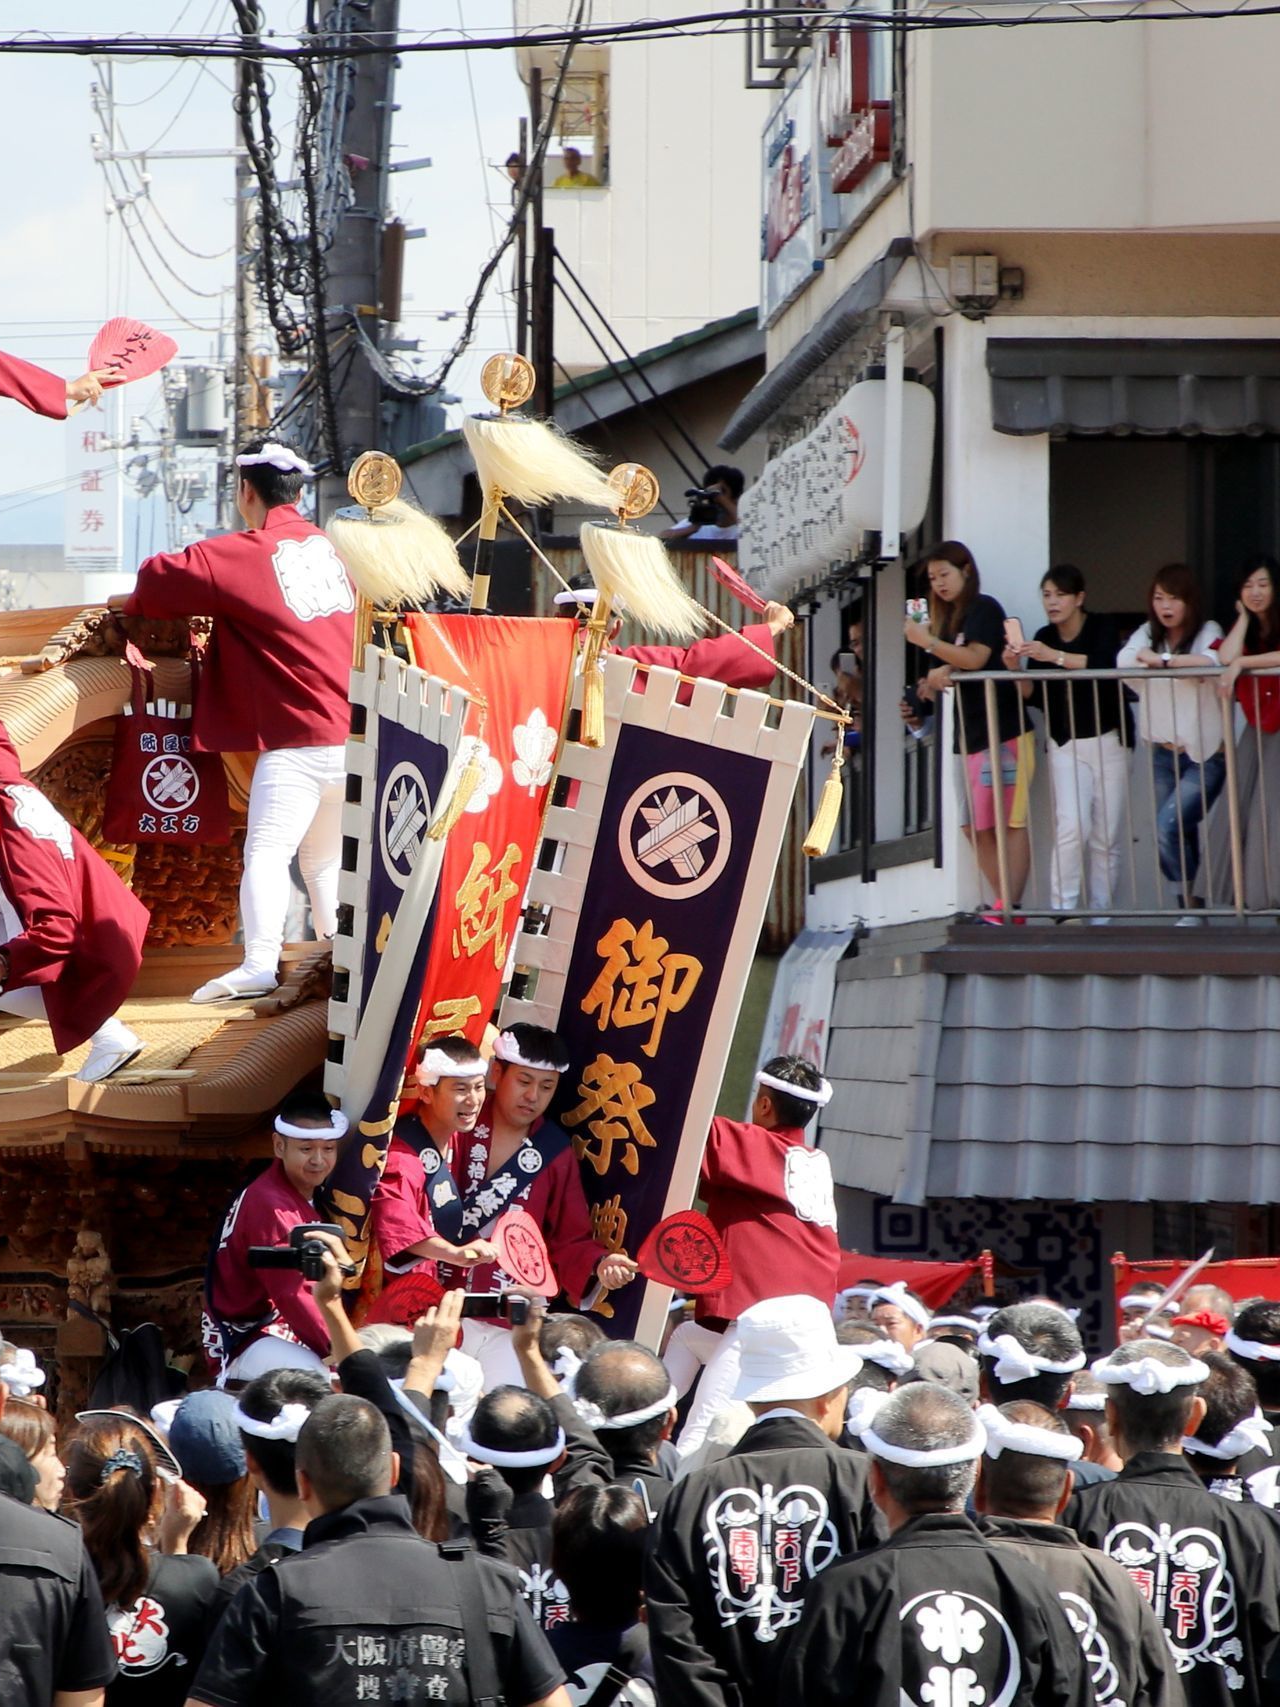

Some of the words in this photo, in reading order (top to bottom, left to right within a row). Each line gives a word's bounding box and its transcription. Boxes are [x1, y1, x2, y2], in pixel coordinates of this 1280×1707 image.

[139, 813, 199, 833] 大工方
[775, 1529, 801, 1593] 天下
[1171, 1572, 1200, 1639] 天下
